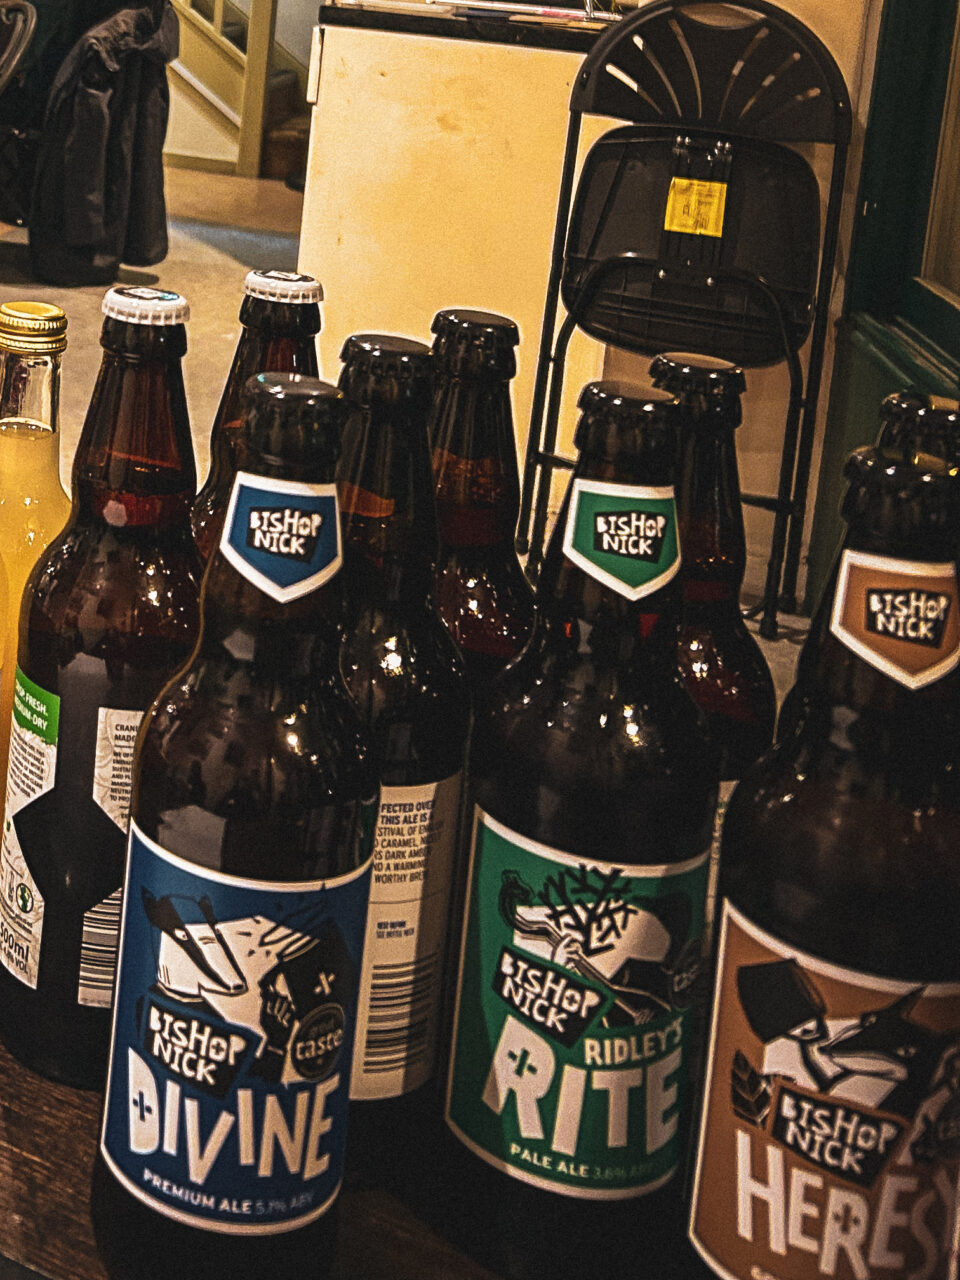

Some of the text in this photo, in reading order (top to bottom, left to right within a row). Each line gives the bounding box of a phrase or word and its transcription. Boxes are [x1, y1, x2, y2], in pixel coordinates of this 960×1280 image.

[250, 509, 323, 537] BISHOP
[253, 530, 305, 556] NICK
[596, 512, 666, 538] BISHOP
[602, 532, 653, 556] NICK
[869, 591, 949, 621] BISHOP
[876, 612, 935, 641] NICK
[500, 951, 602, 1019] BISHOP
[501, 980, 569, 1034] NICK
[149, 1005, 247, 1066] BISHOP
[583, 1016, 683, 1066] RIDLEY'S
[153, 1037, 218, 1087] NICK
[481, 1014, 683, 1157] RITE
[127, 1046, 340, 1186] DIVINE
[780, 1093, 899, 1154] BISHOP
[510, 1142, 552, 1170] PALE
[557, 1160, 589, 1178] ALE
[785, 1123, 866, 1176] NICK
[143, 1167, 216, 1210] PREMIUM
[218, 1197, 253, 1214] ALE
